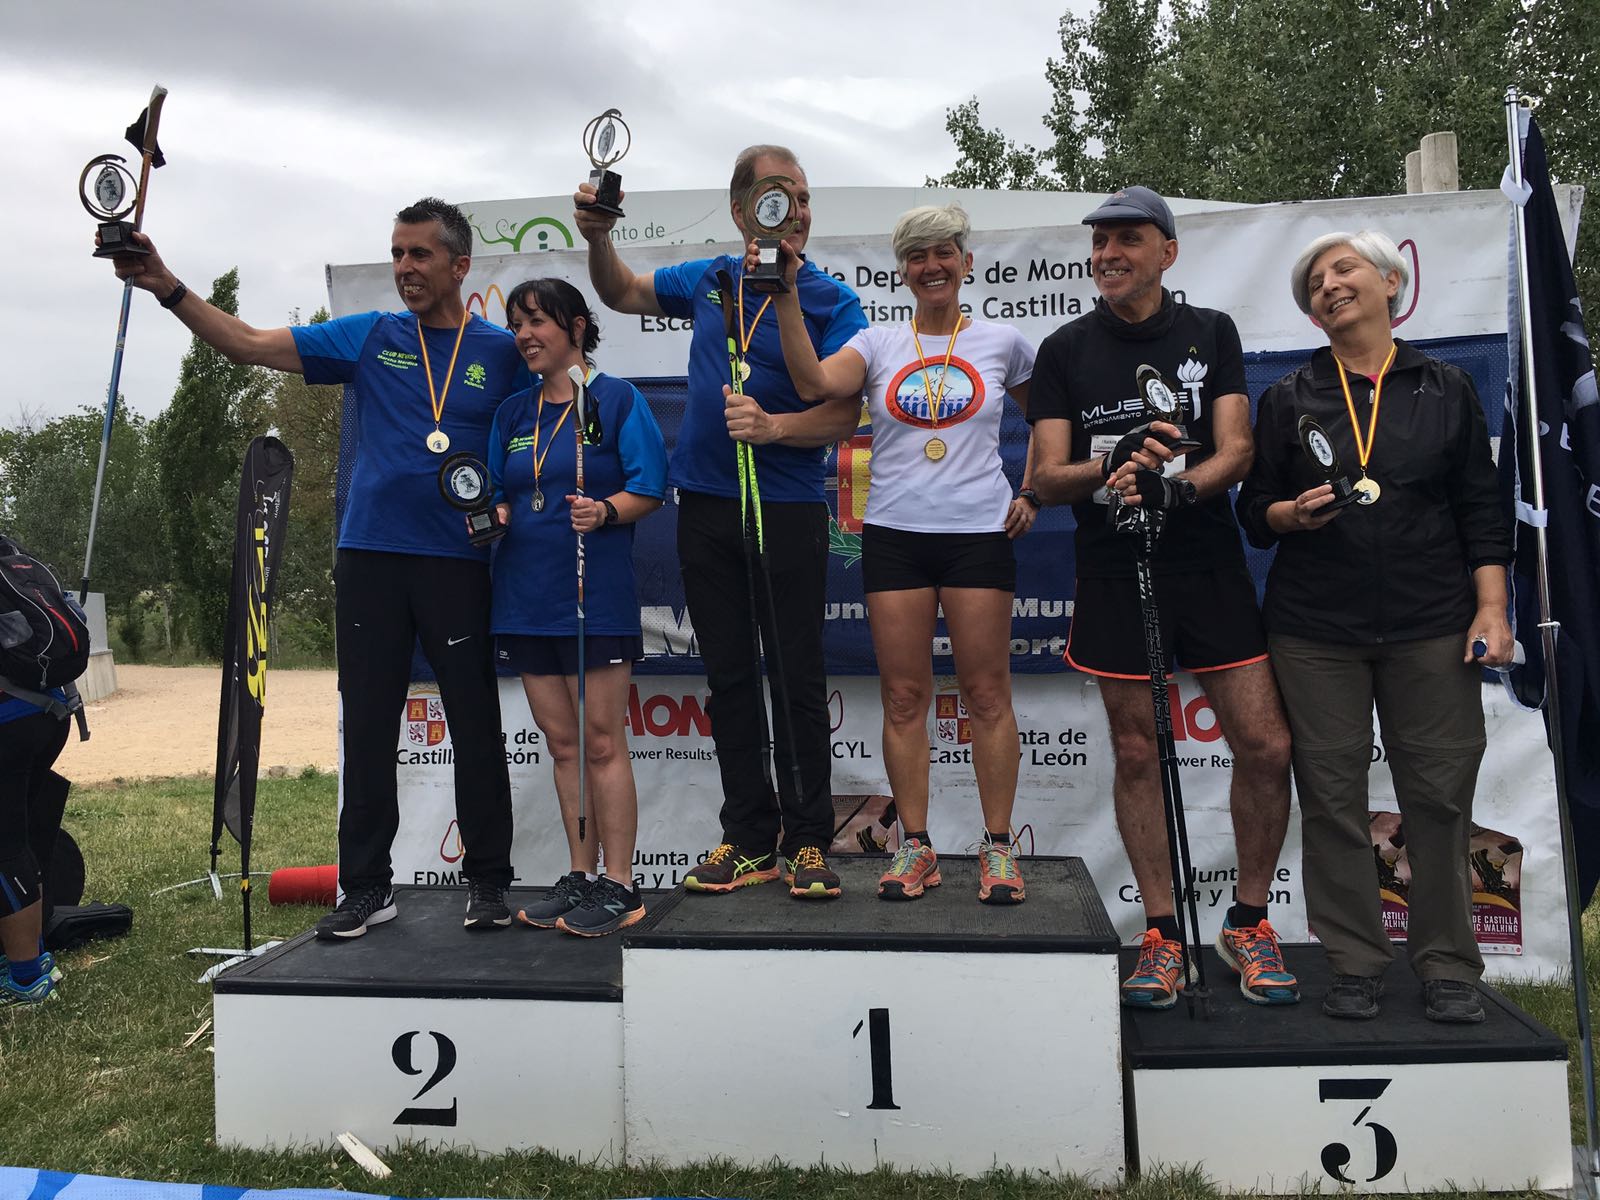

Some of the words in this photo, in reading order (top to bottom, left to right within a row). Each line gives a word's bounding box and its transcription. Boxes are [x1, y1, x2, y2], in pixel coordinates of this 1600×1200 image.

[611, 226, 638, 241] nto
[645, 222, 665, 239] de
[985, 261, 1018, 284] de
[1027, 257, 1093, 282] Mont
[640, 315, 694, 332] Esca
[983, 293, 1081, 319] Castilla
[514, 729, 539, 745] de
[1018, 730, 1050, 745] nta
[1058, 728, 1087, 745] de
[396, 749, 456, 765] Castill
[505, 748, 540, 765] eón
[629, 749, 662, 760] ower
[666, 748, 712, 760] Results
[930, 747, 972, 764] Cast
[1031, 749, 1087, 766] León
[632, 850, 689, 866] Junta
[1190, 866, 1239, 884] Junt
[1382, 911, 1408, 921] ASTILL
[1484, 916, 1519, 926] CASTILLA
[853, 1007, 901, 1110] 1
[391, 1030, 458, 1127] 2
[1319, 1078, 1398, 1185] 3
